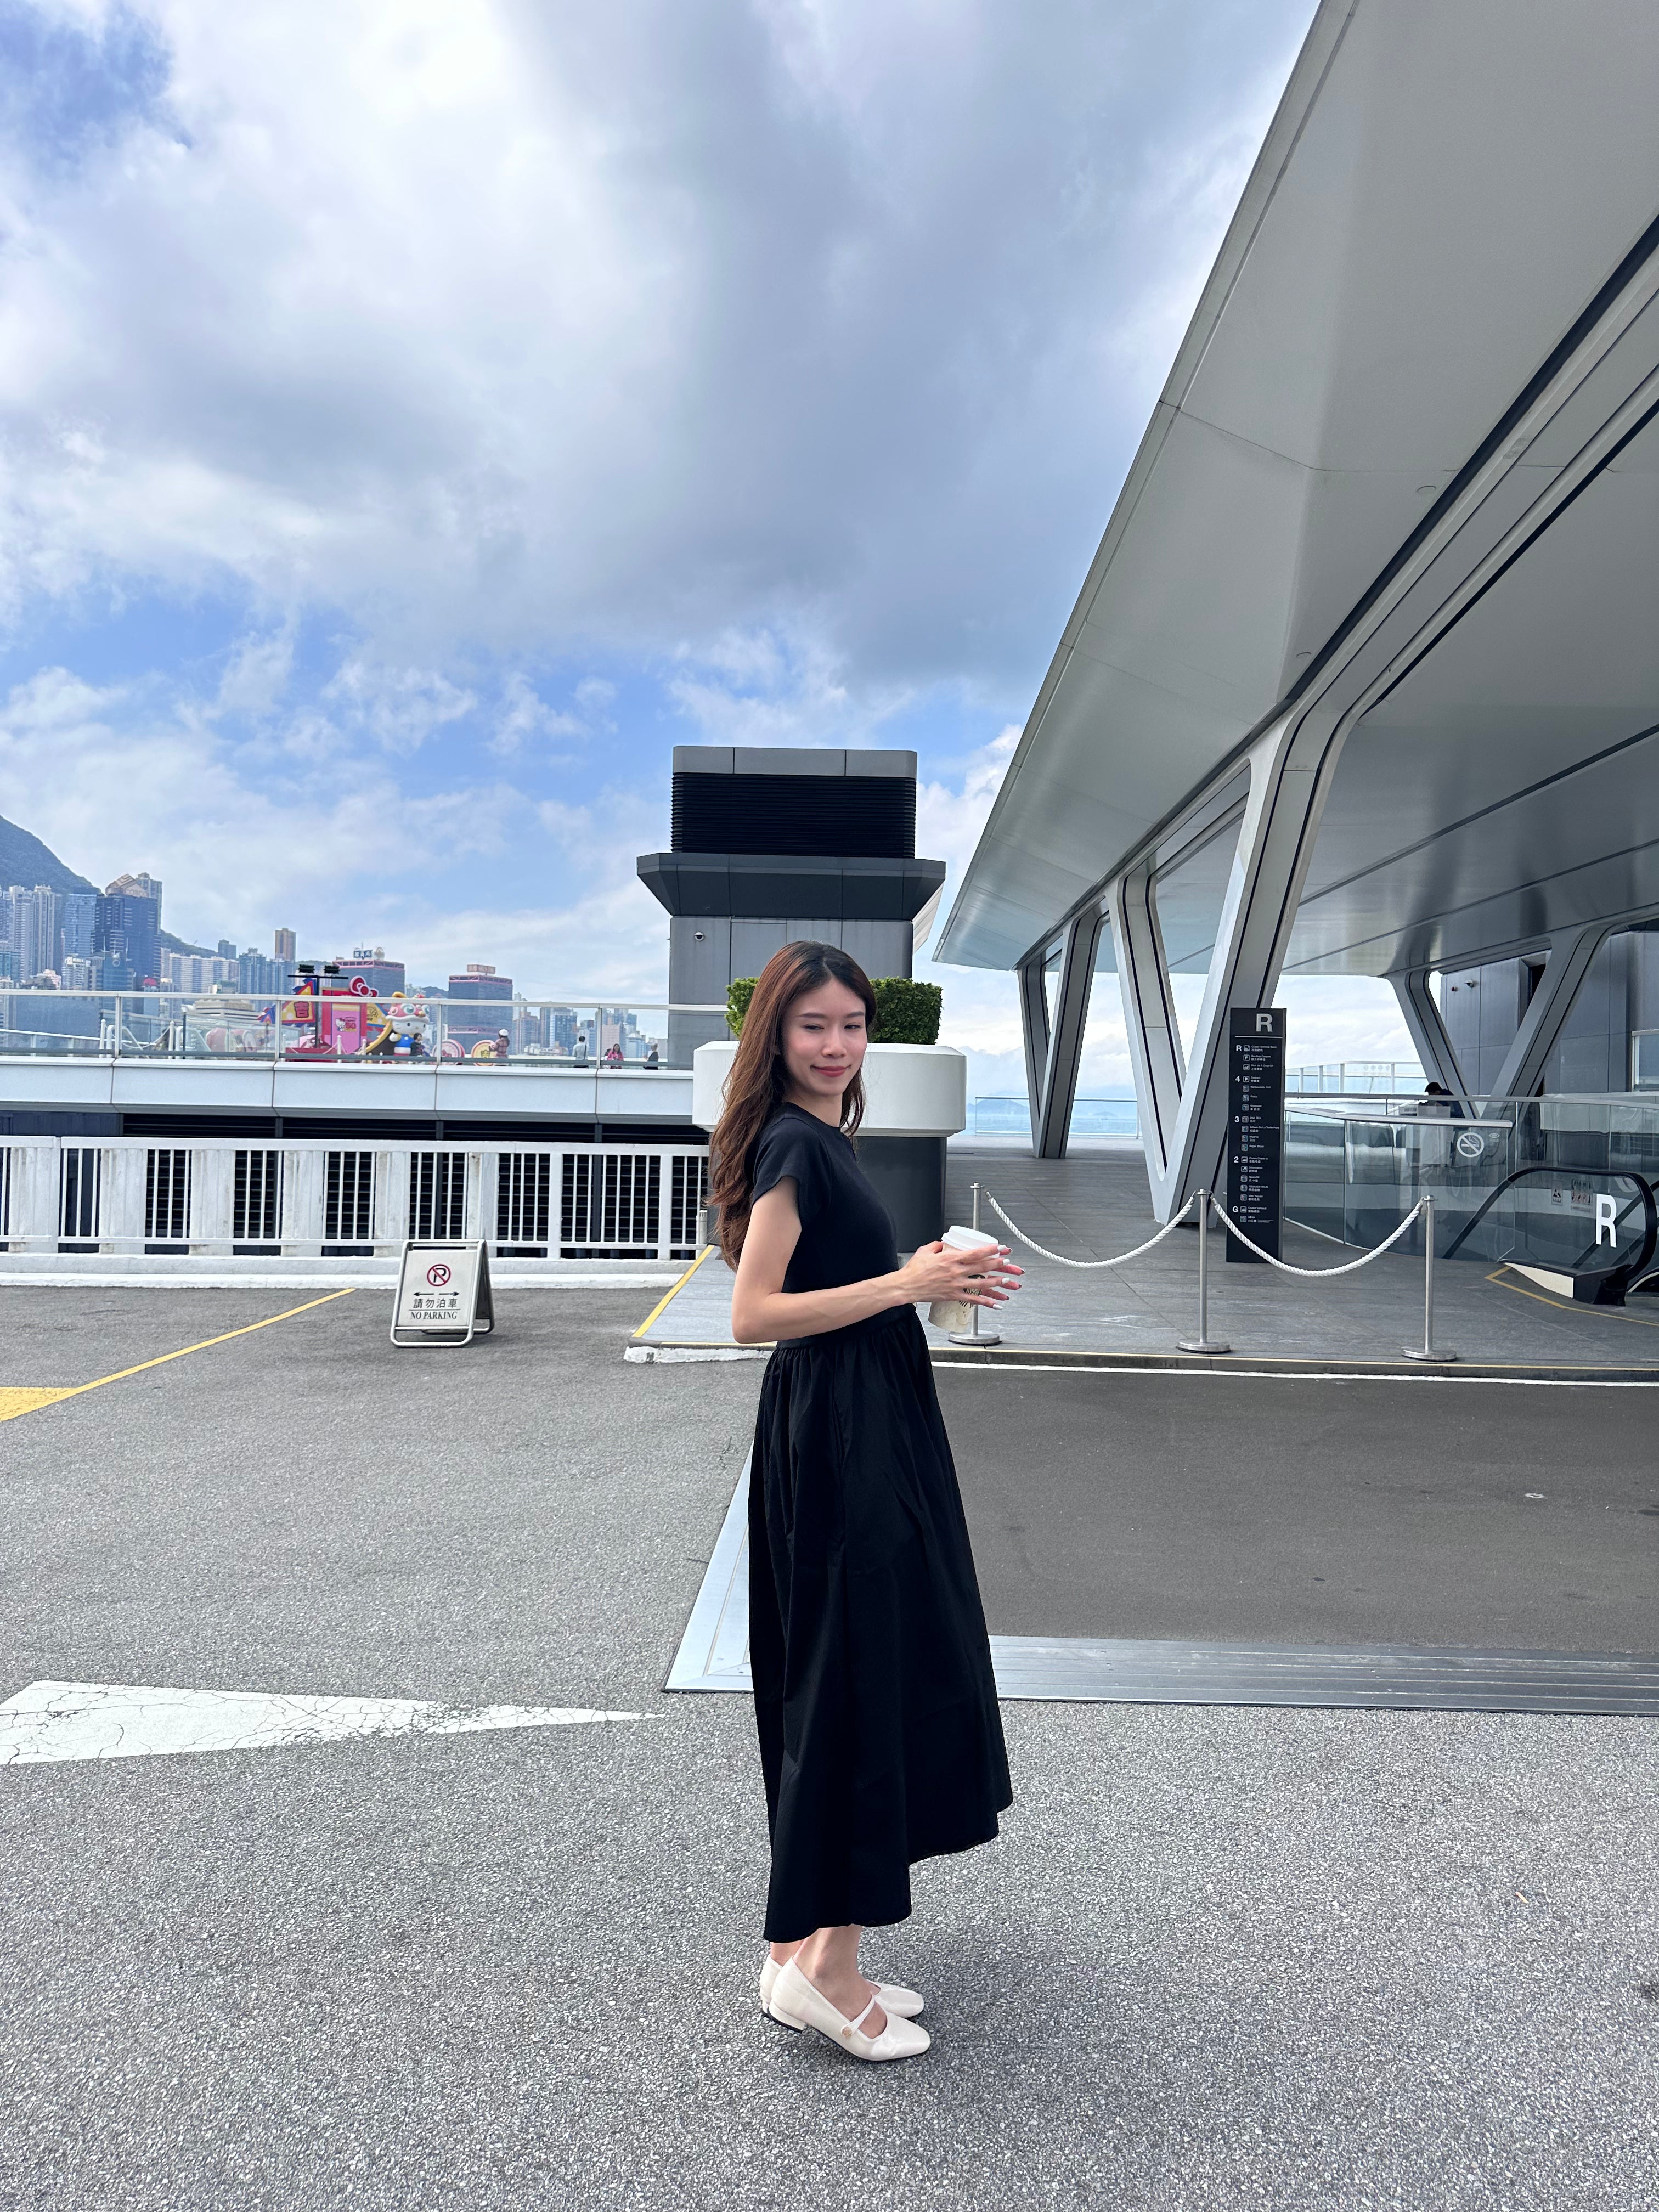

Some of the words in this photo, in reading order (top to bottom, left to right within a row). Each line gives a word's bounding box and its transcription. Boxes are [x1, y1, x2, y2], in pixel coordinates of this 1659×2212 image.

[1256, 1013, 1273, 1032] R
[1595, 1193, 1617, 1248] R
[413, 1298, 458, 1308] 請勿泊車
[411, 1311, 422, 1319] NO
[423, 1311, 458, 1319] PARKING
